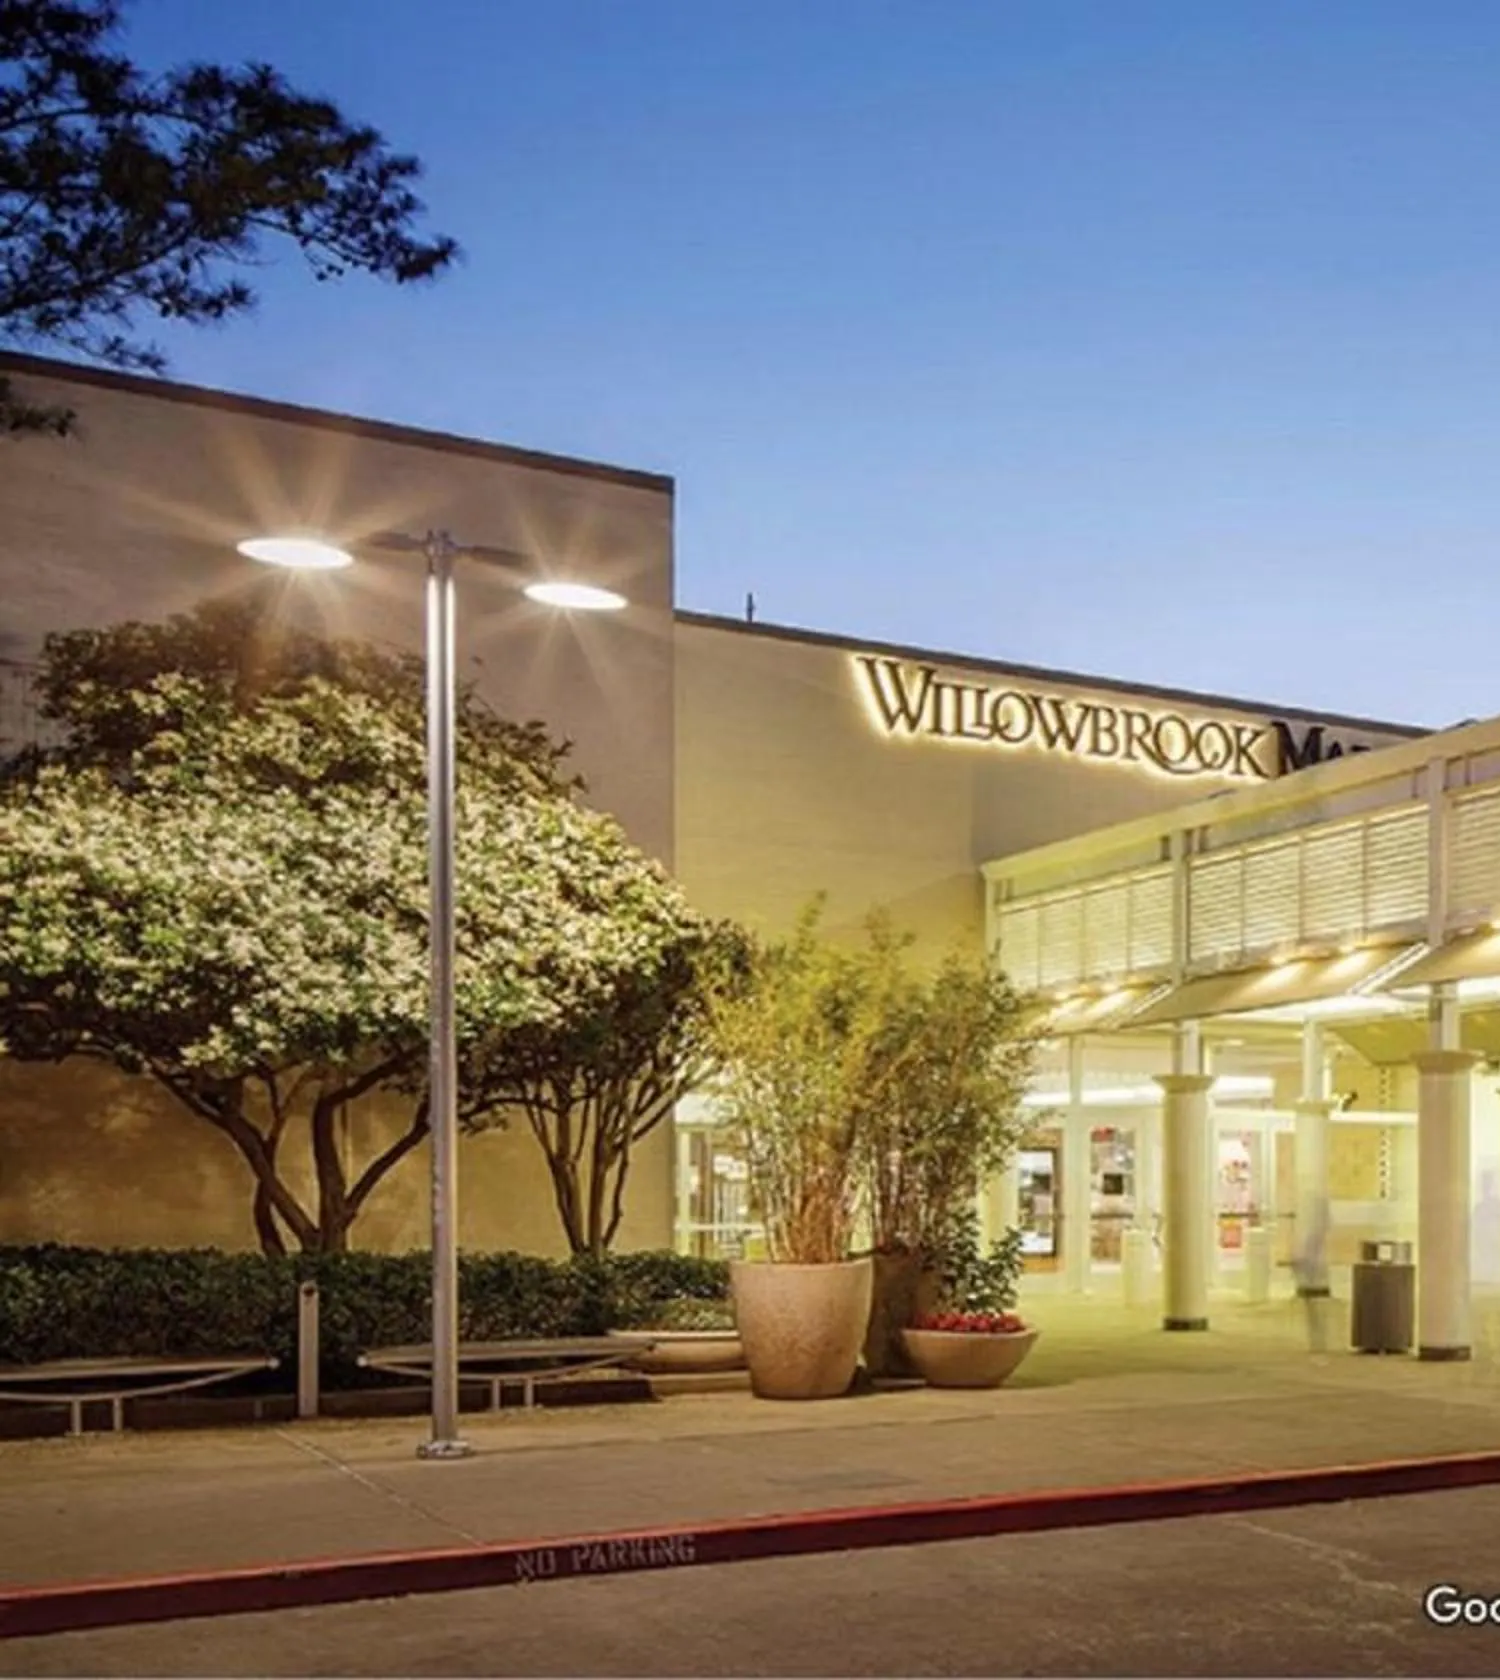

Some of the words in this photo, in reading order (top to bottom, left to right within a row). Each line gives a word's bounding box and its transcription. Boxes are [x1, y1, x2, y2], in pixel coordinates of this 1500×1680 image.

[856, 656, 1271, 778] WILLOWBROOK
[515, 1550, 557, 1577] NO
[569, 1535, 696, 1571] PARKING
